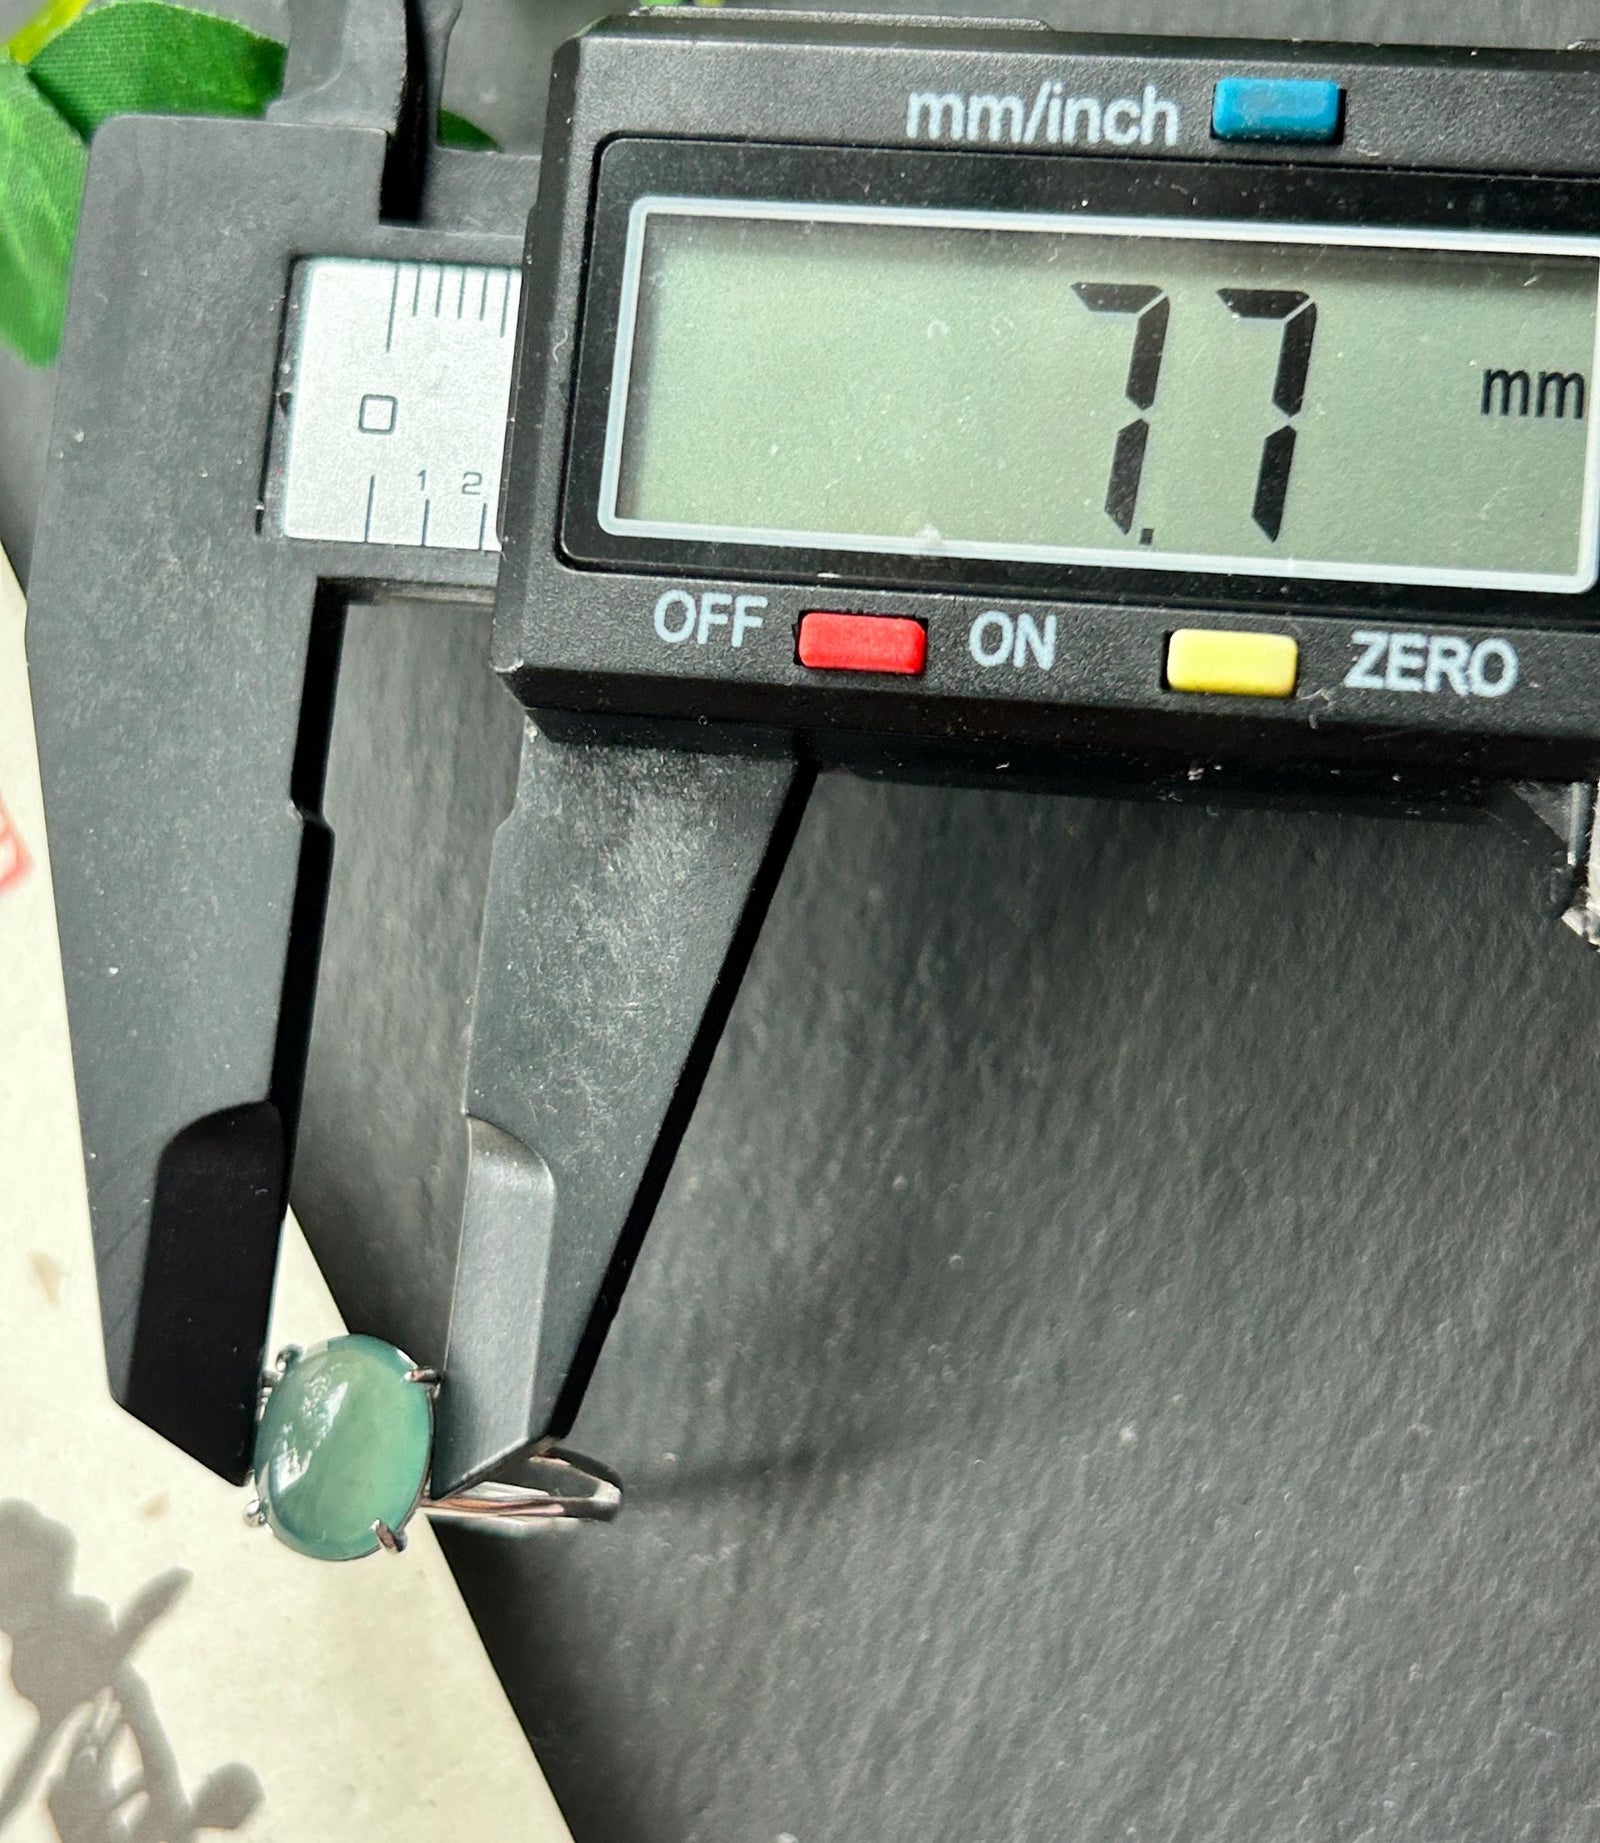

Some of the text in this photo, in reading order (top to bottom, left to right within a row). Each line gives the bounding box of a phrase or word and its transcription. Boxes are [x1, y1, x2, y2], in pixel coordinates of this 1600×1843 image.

[906, 82, 1180, 147] mm/inch
[1070, 281, 1586, 546] 7.7 mm
[416, 468, 484, 495] 1 2
[652, 589, 1518, 698] OFF ON ZERO
